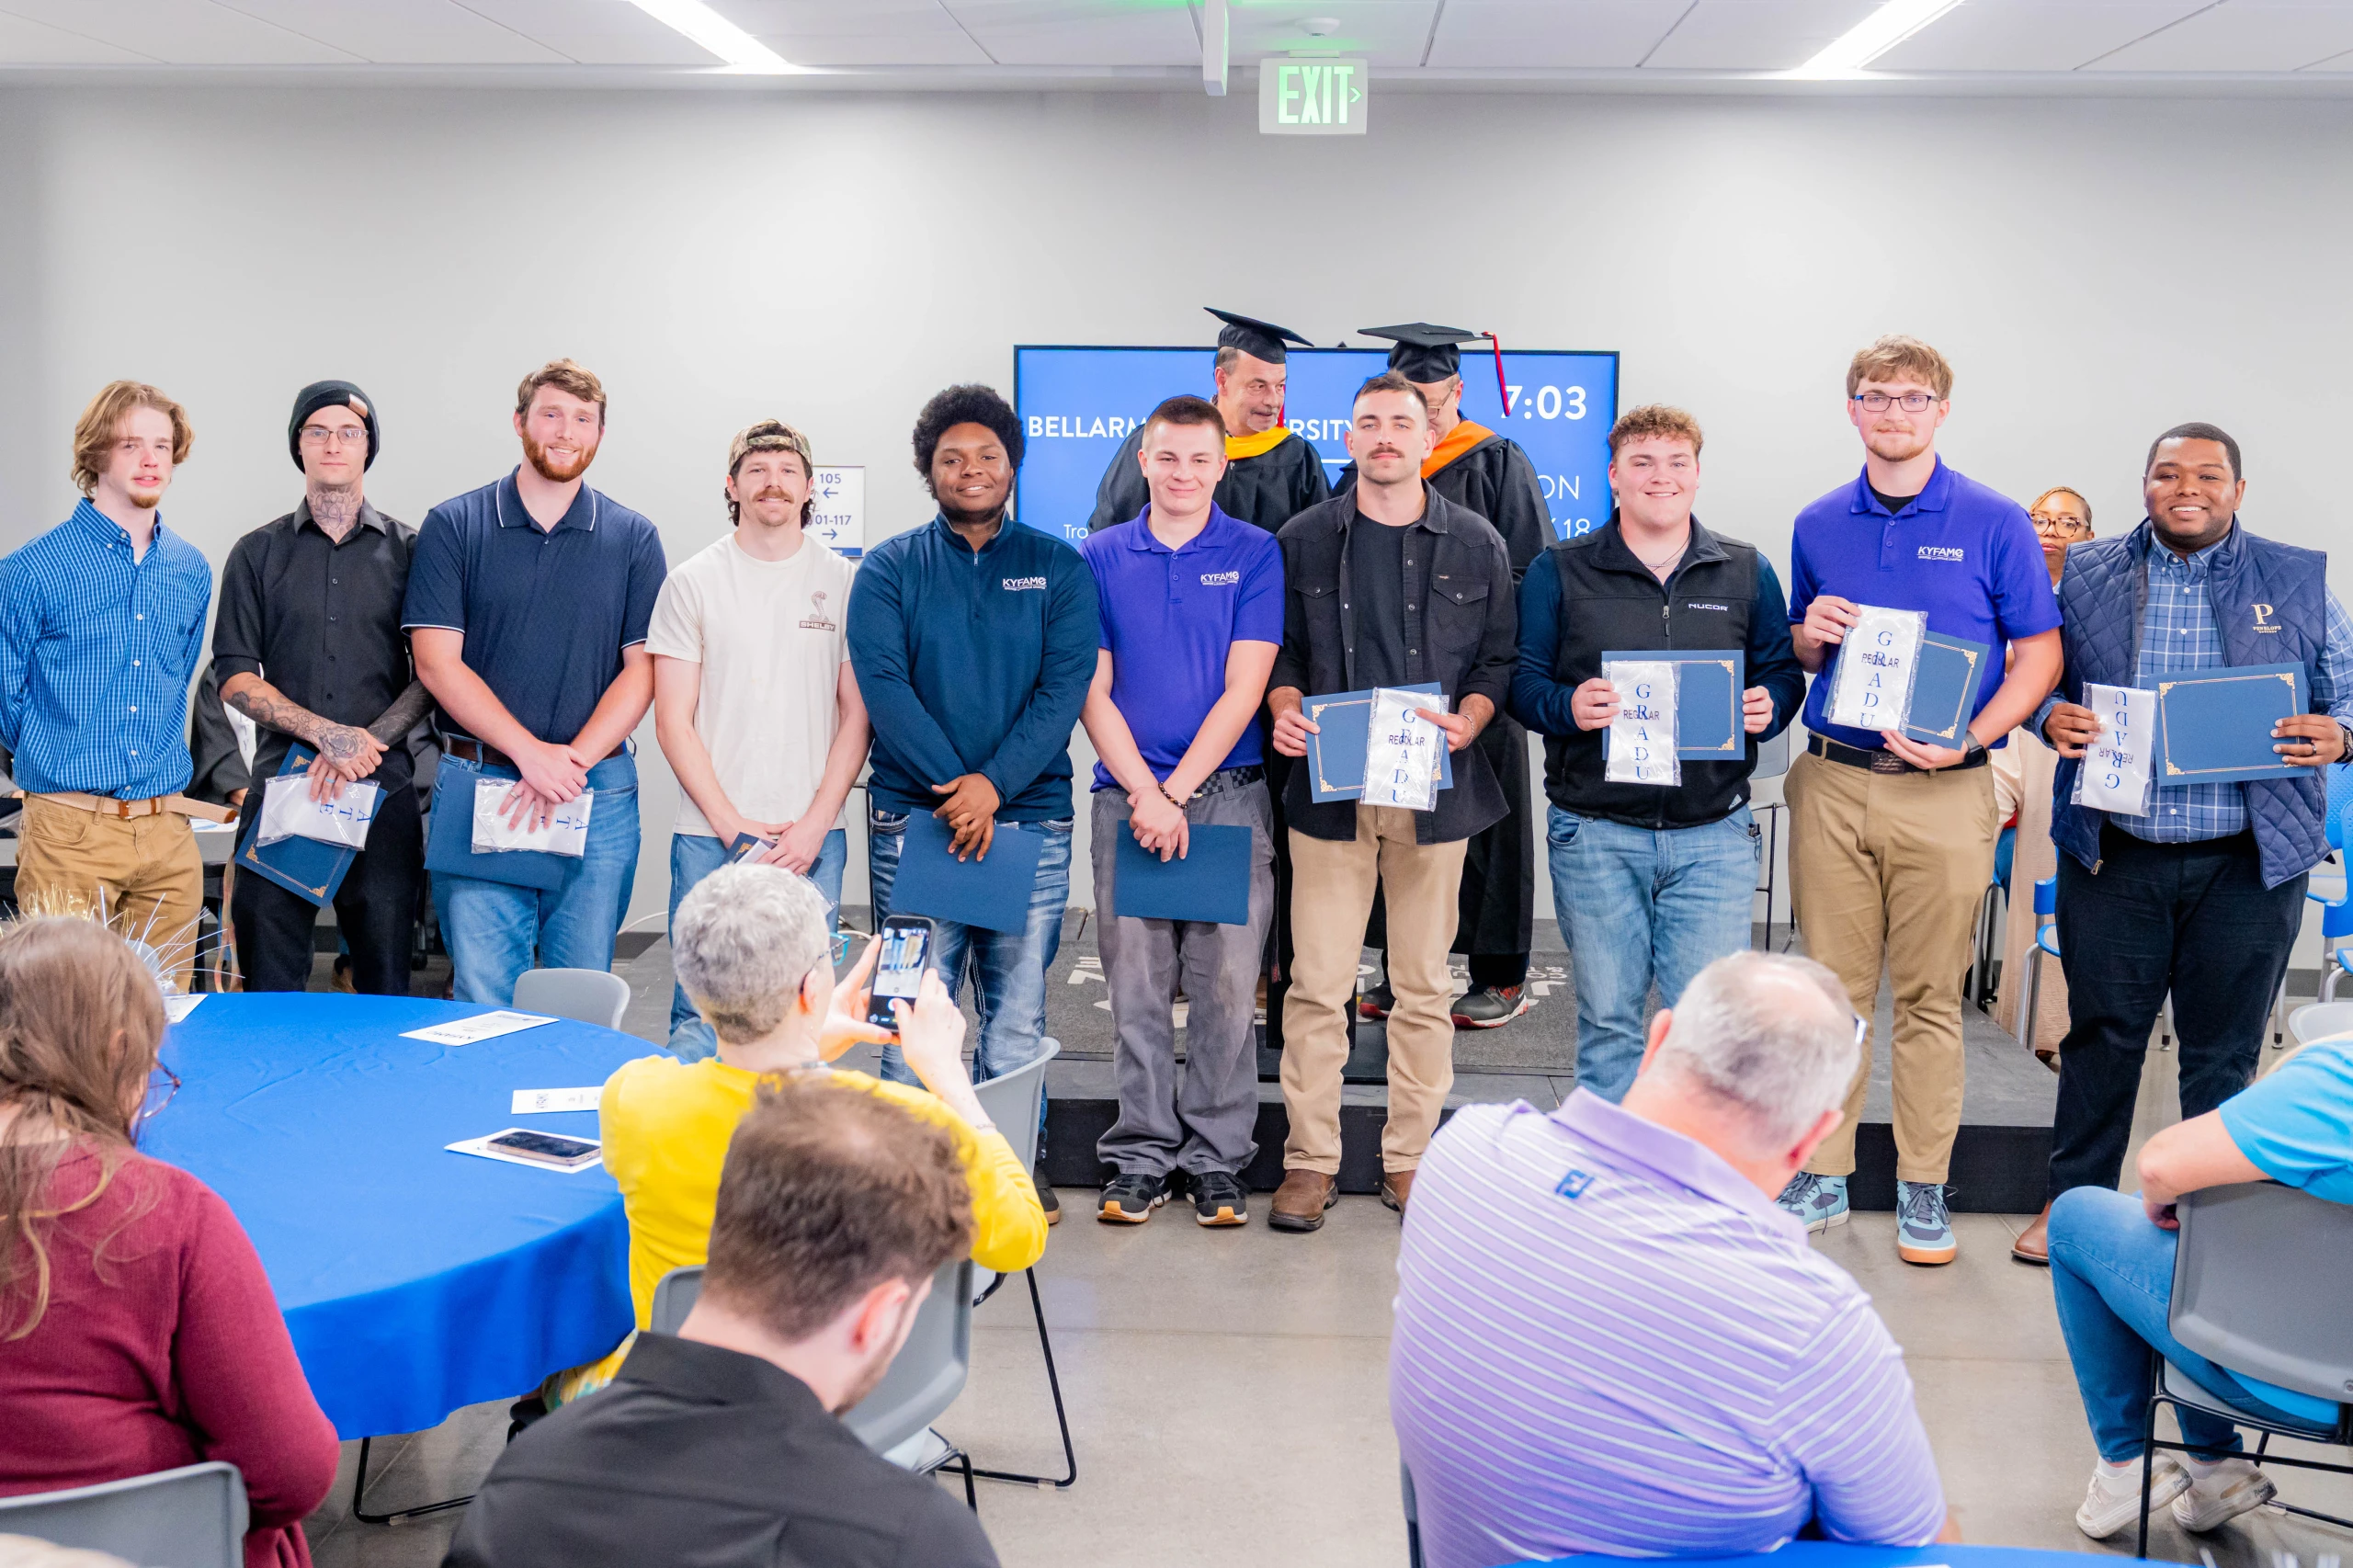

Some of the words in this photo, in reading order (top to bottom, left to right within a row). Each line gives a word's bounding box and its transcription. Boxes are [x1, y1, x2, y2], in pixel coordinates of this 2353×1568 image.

[1279, 65, 1355, 124] EXIT
[1501, 385, 1587, 421] 7:03
[820, 473, 842, 484] 105
[813, 515, 852, 526] 01-117
[1688, 603, 1729, 612] NUCOR
[2251, 603, 2274, 625] P
